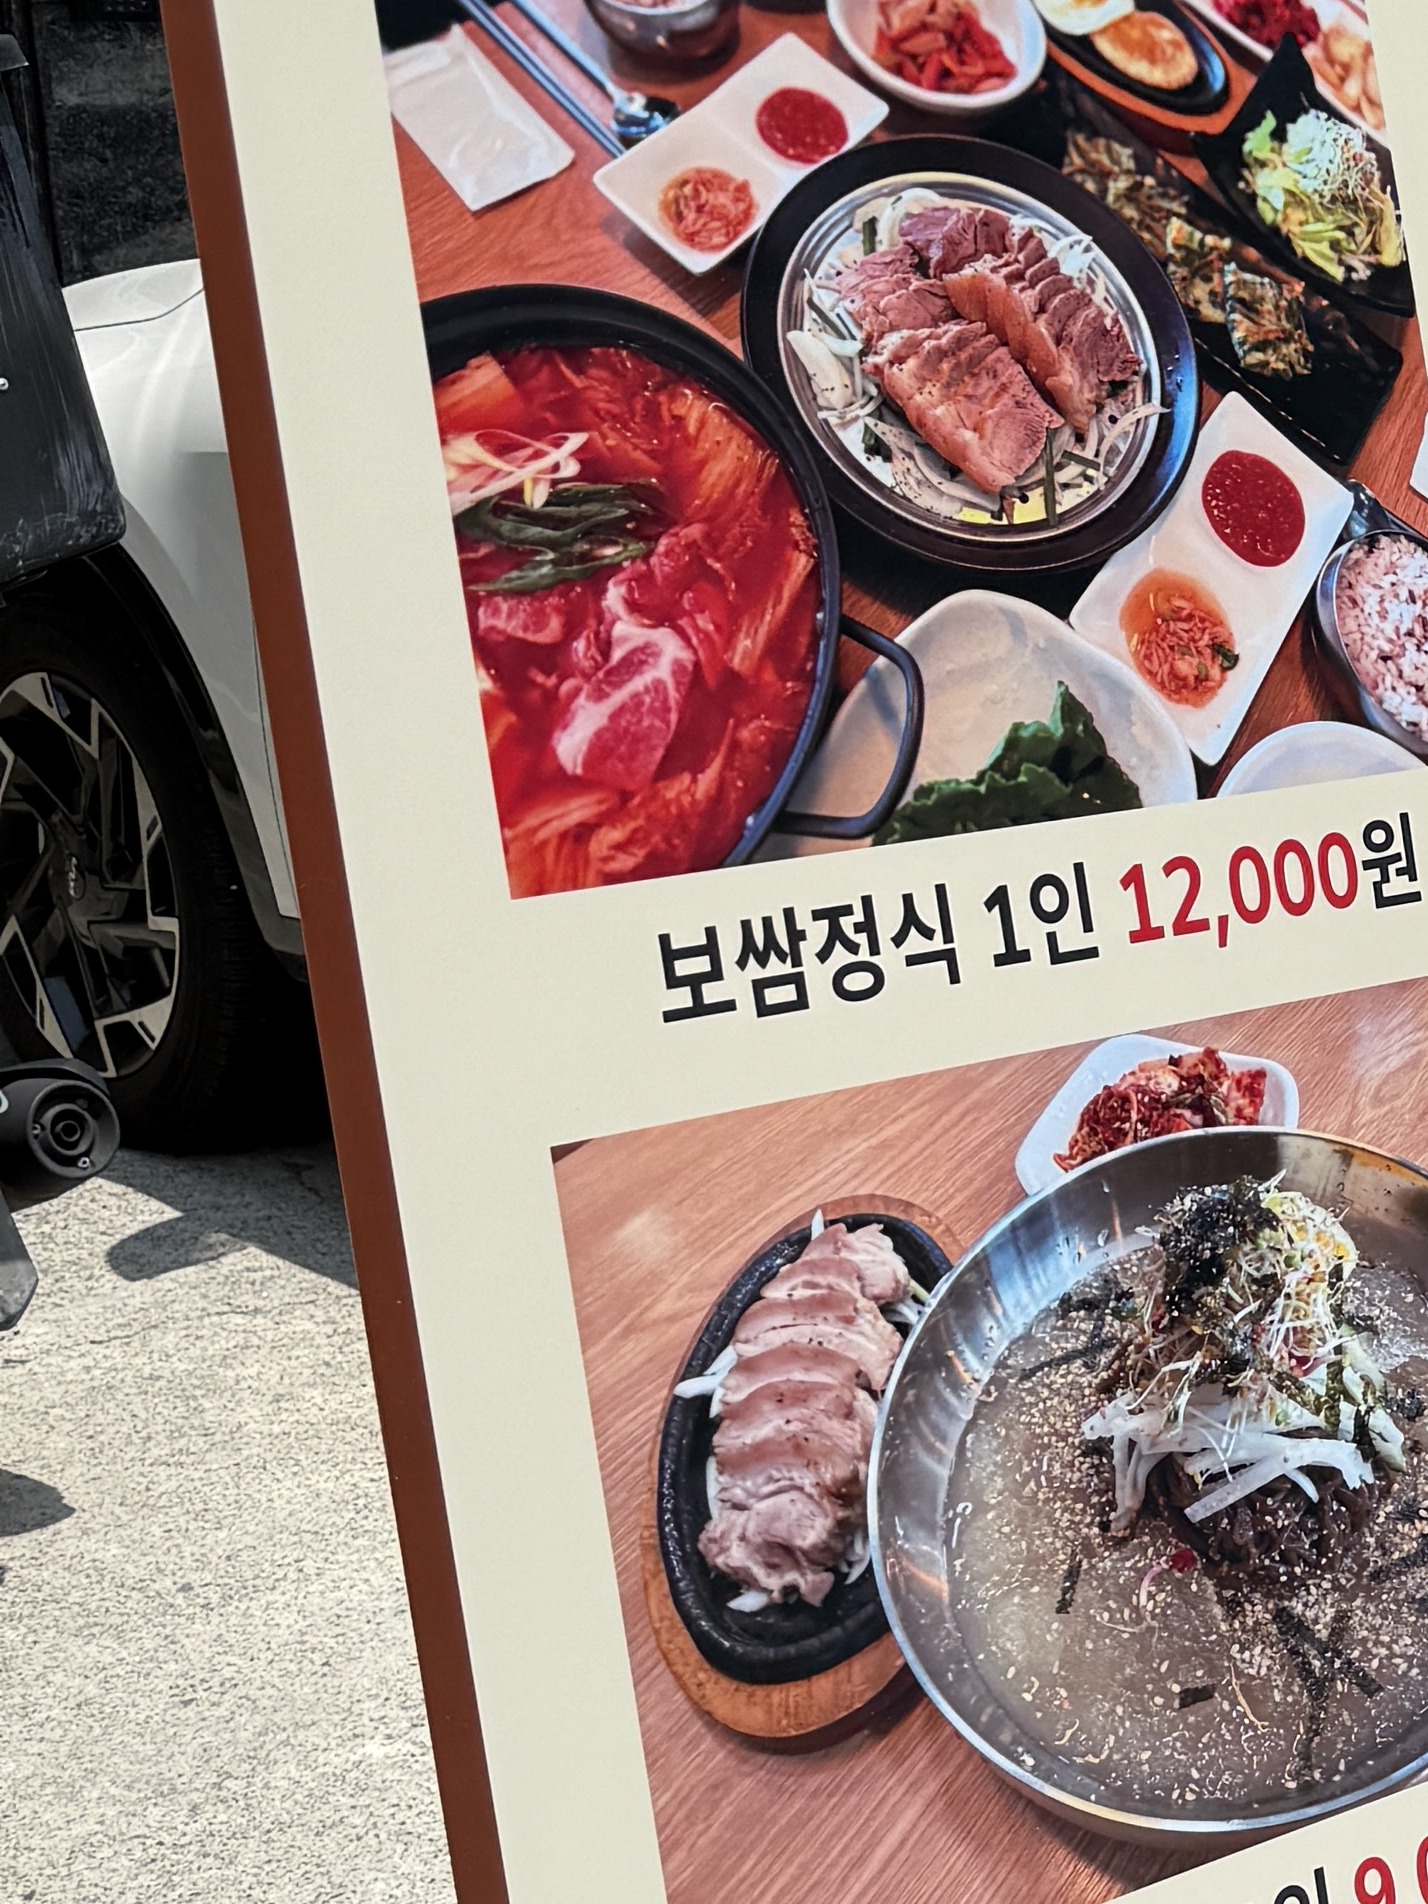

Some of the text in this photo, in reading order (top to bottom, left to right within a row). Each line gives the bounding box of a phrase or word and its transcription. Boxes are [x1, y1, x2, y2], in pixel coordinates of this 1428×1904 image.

[658, 812, 1423, 1024] 보쌈정식 1인 12,000원
